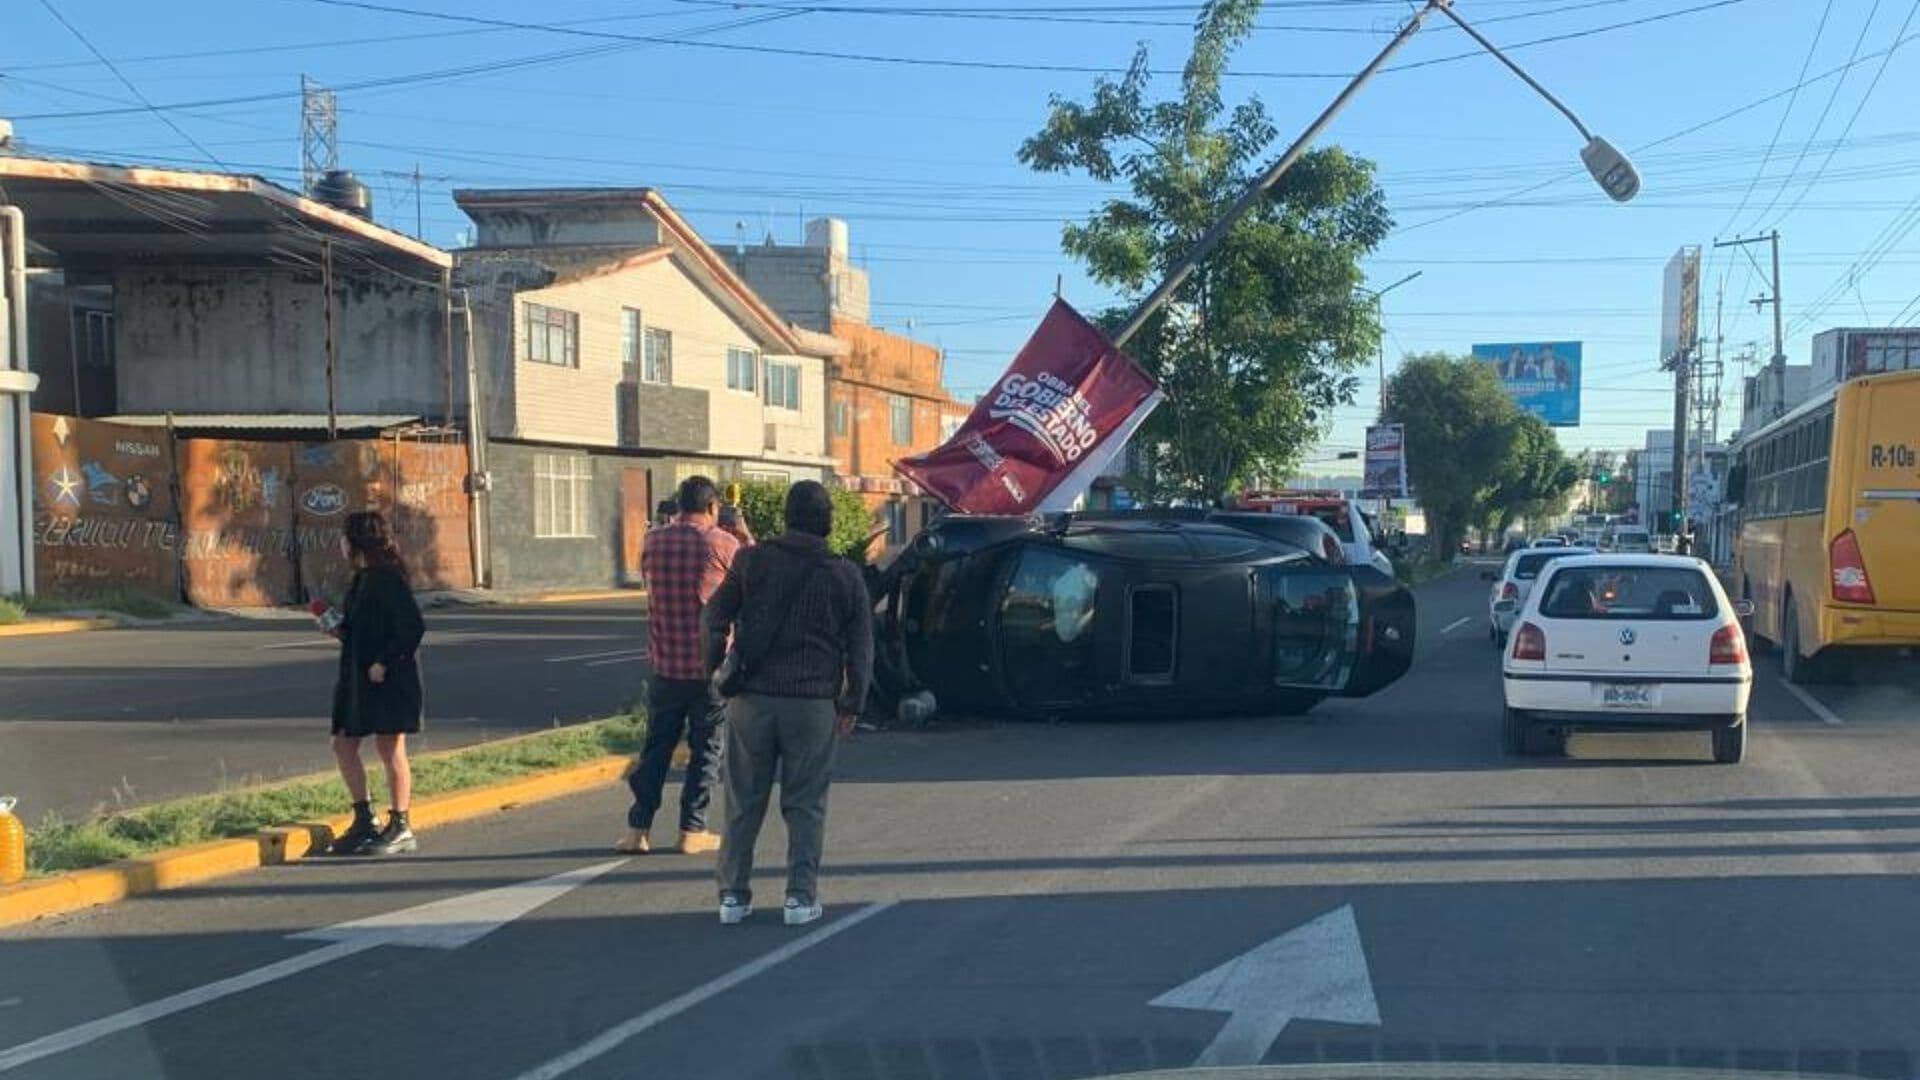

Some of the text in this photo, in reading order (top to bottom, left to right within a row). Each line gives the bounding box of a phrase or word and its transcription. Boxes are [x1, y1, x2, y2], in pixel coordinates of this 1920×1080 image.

[1038, 372, 1074, 395] OBRA
[1001, 373, 1097, 449] GOBIERNO
[1024, 402, 1081, 461] ESTADO
[115, 441, 160, 457] NISSAN
[306, 488, 341, 509] Ford
